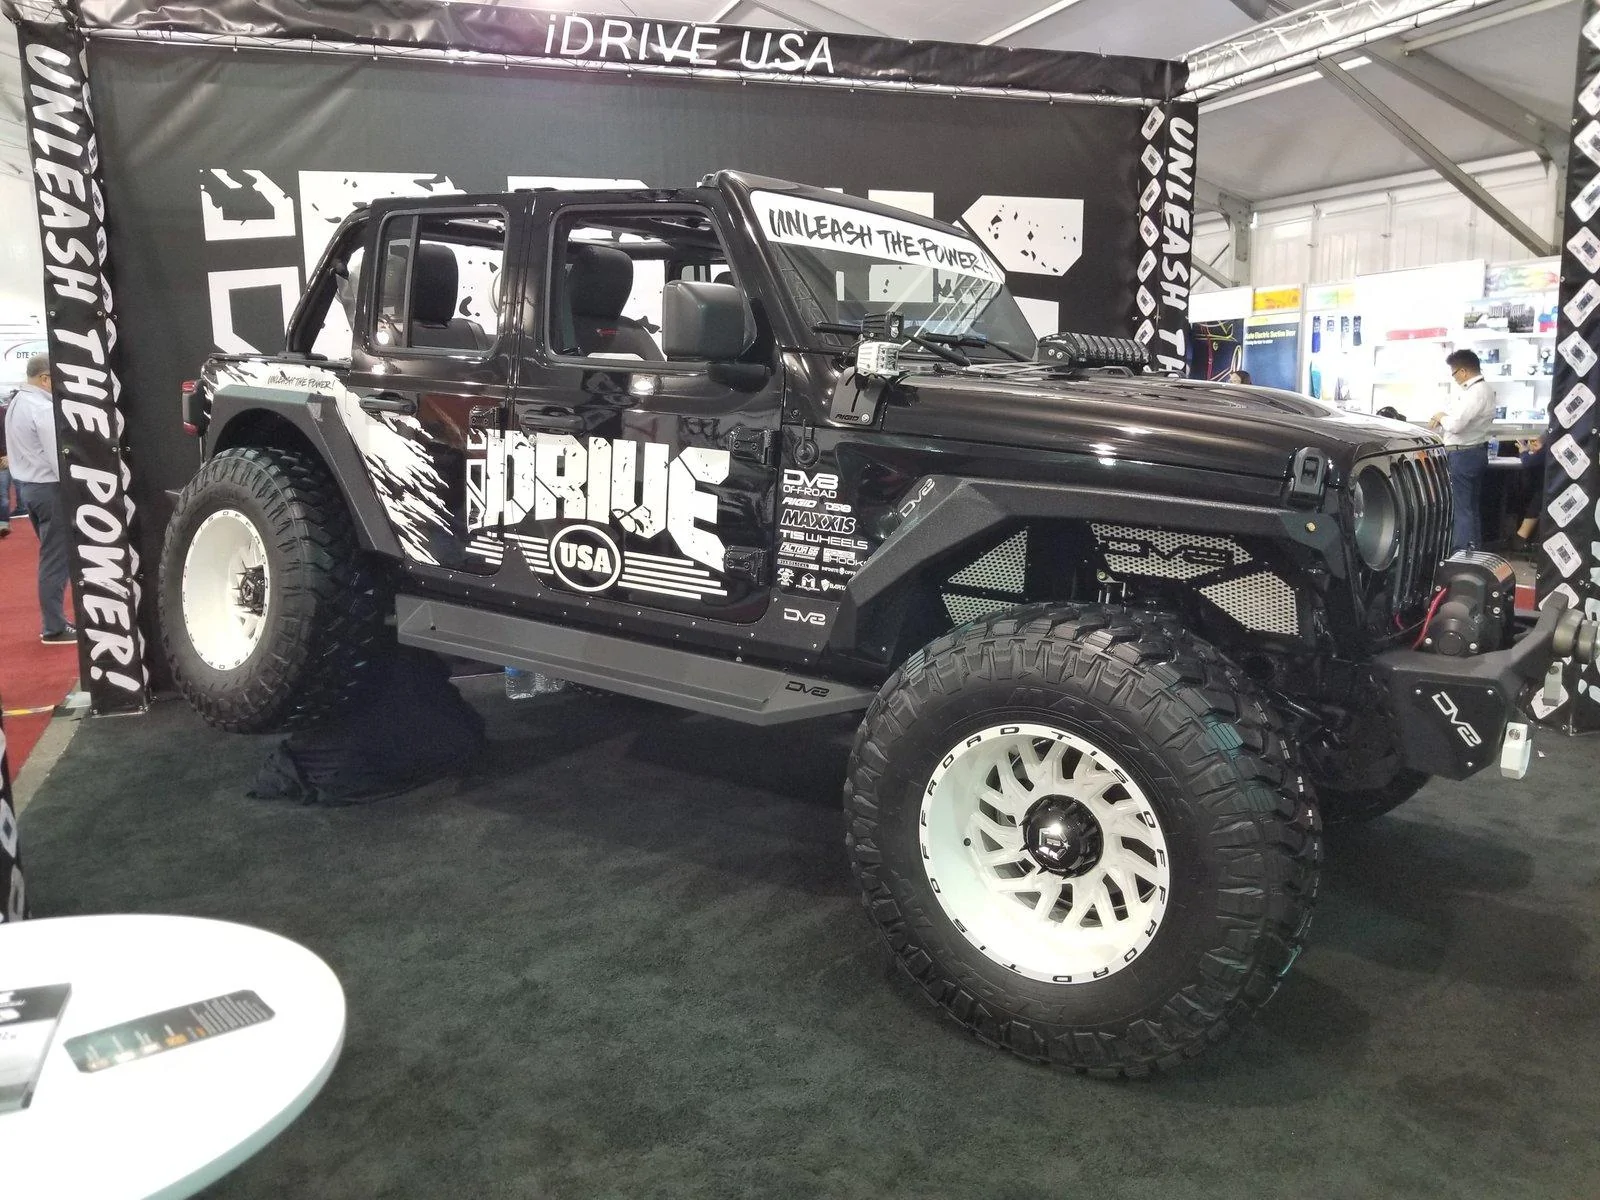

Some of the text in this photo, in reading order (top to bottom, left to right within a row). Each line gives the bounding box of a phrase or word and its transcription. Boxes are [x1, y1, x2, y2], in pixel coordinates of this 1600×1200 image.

[544, 14, 834, 74] iDRIVE USA
[769, 208, 872, 249] UNLEASH
[876, 229, 921, 257] THE
[1157, 116, 1194, 379] UNLEASH TH
[16, 351, 30, 359] DTE
[25, 43, 140, 691] UNLEASH THE POWER!
[834, 413, 859, 421] RIGID
[783, 469, 839, 490] DV8
[782, 497, 817, 508] RIGID
[899, 478, 936, 518] DV8
[780, 509, 857, 535] MAXXIS
[560, 541, 612, 574] USA
